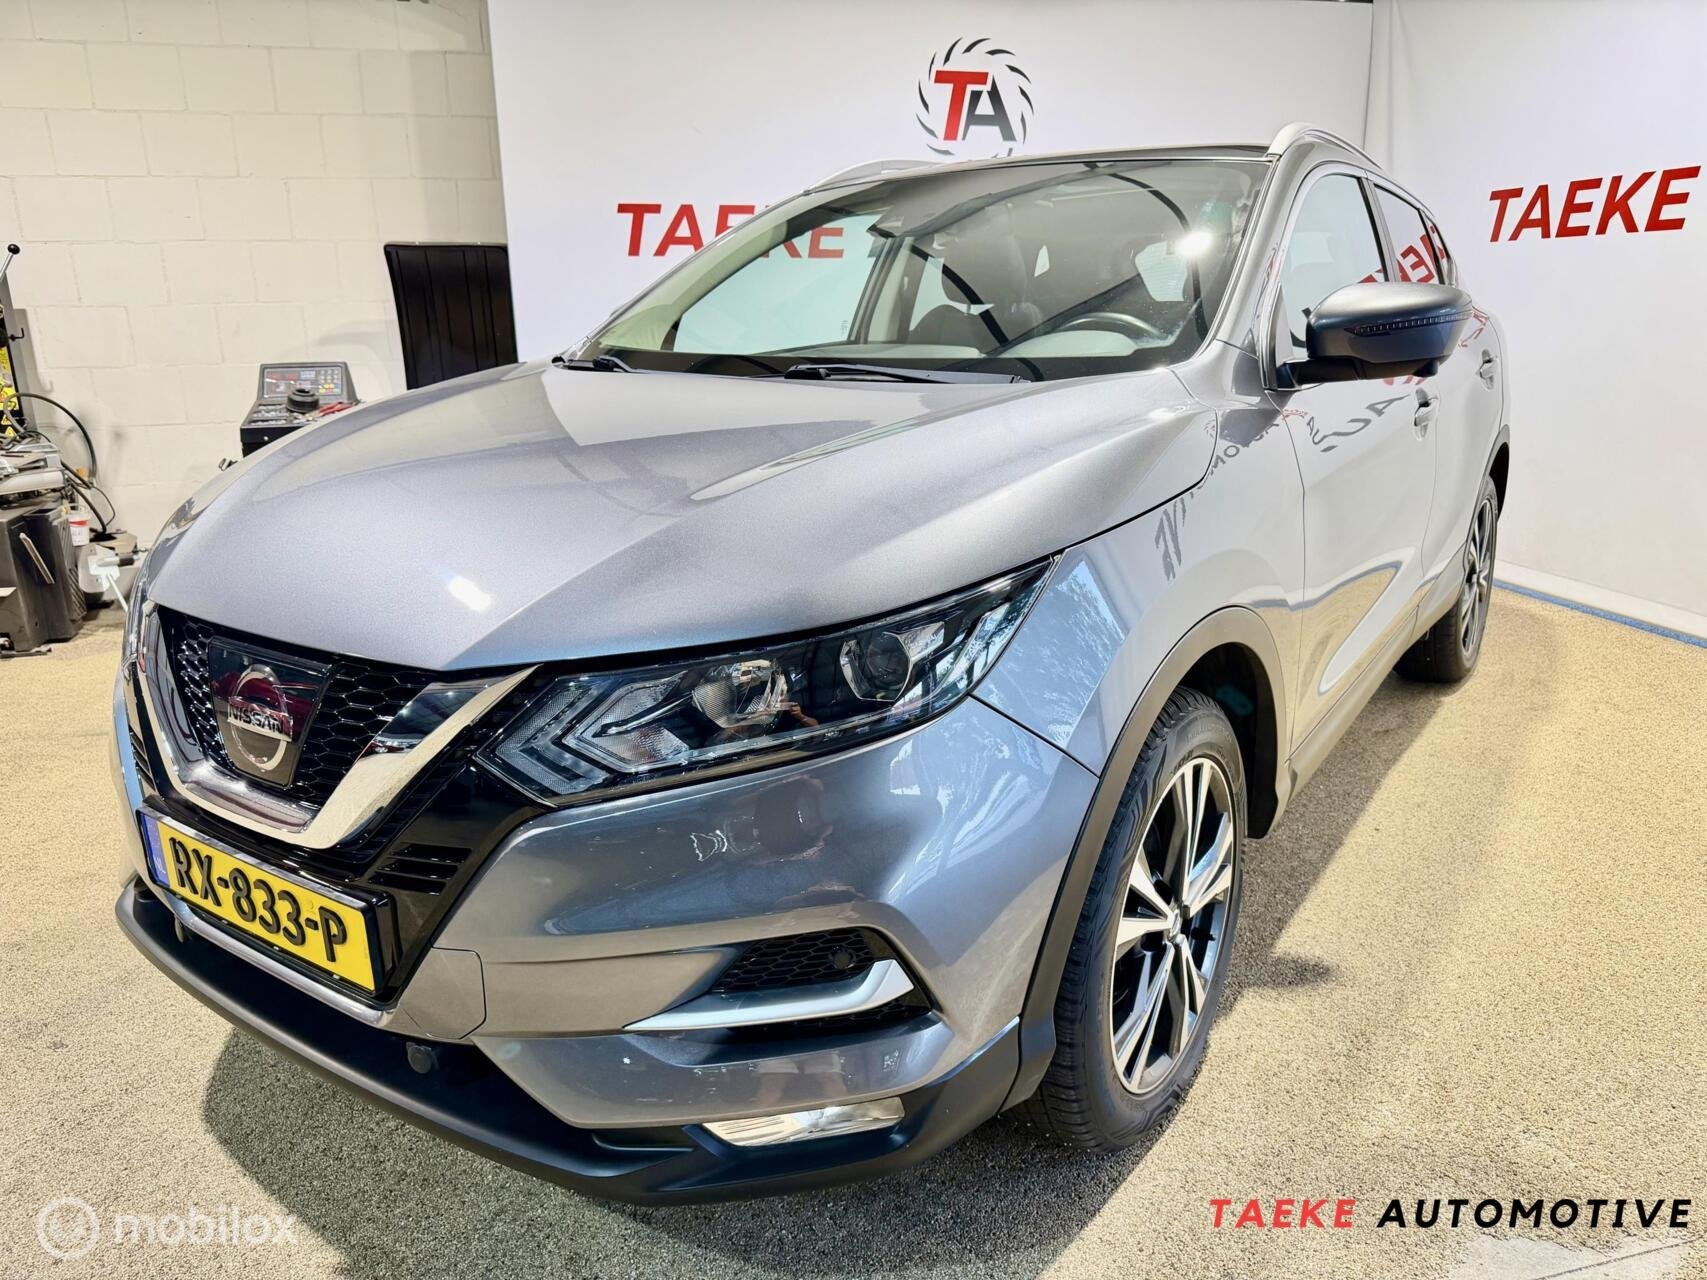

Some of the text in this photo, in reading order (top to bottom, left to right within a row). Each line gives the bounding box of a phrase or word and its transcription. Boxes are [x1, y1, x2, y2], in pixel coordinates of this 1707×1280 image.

[934, 70, 1017, 142] TA
[617, 203, 844, 258] TAE
[1489, 165, 1701, 242] TAEKE
[228, 703, 284, 734] NISSAN
[169, 837, 348, 963] RX-833-P
